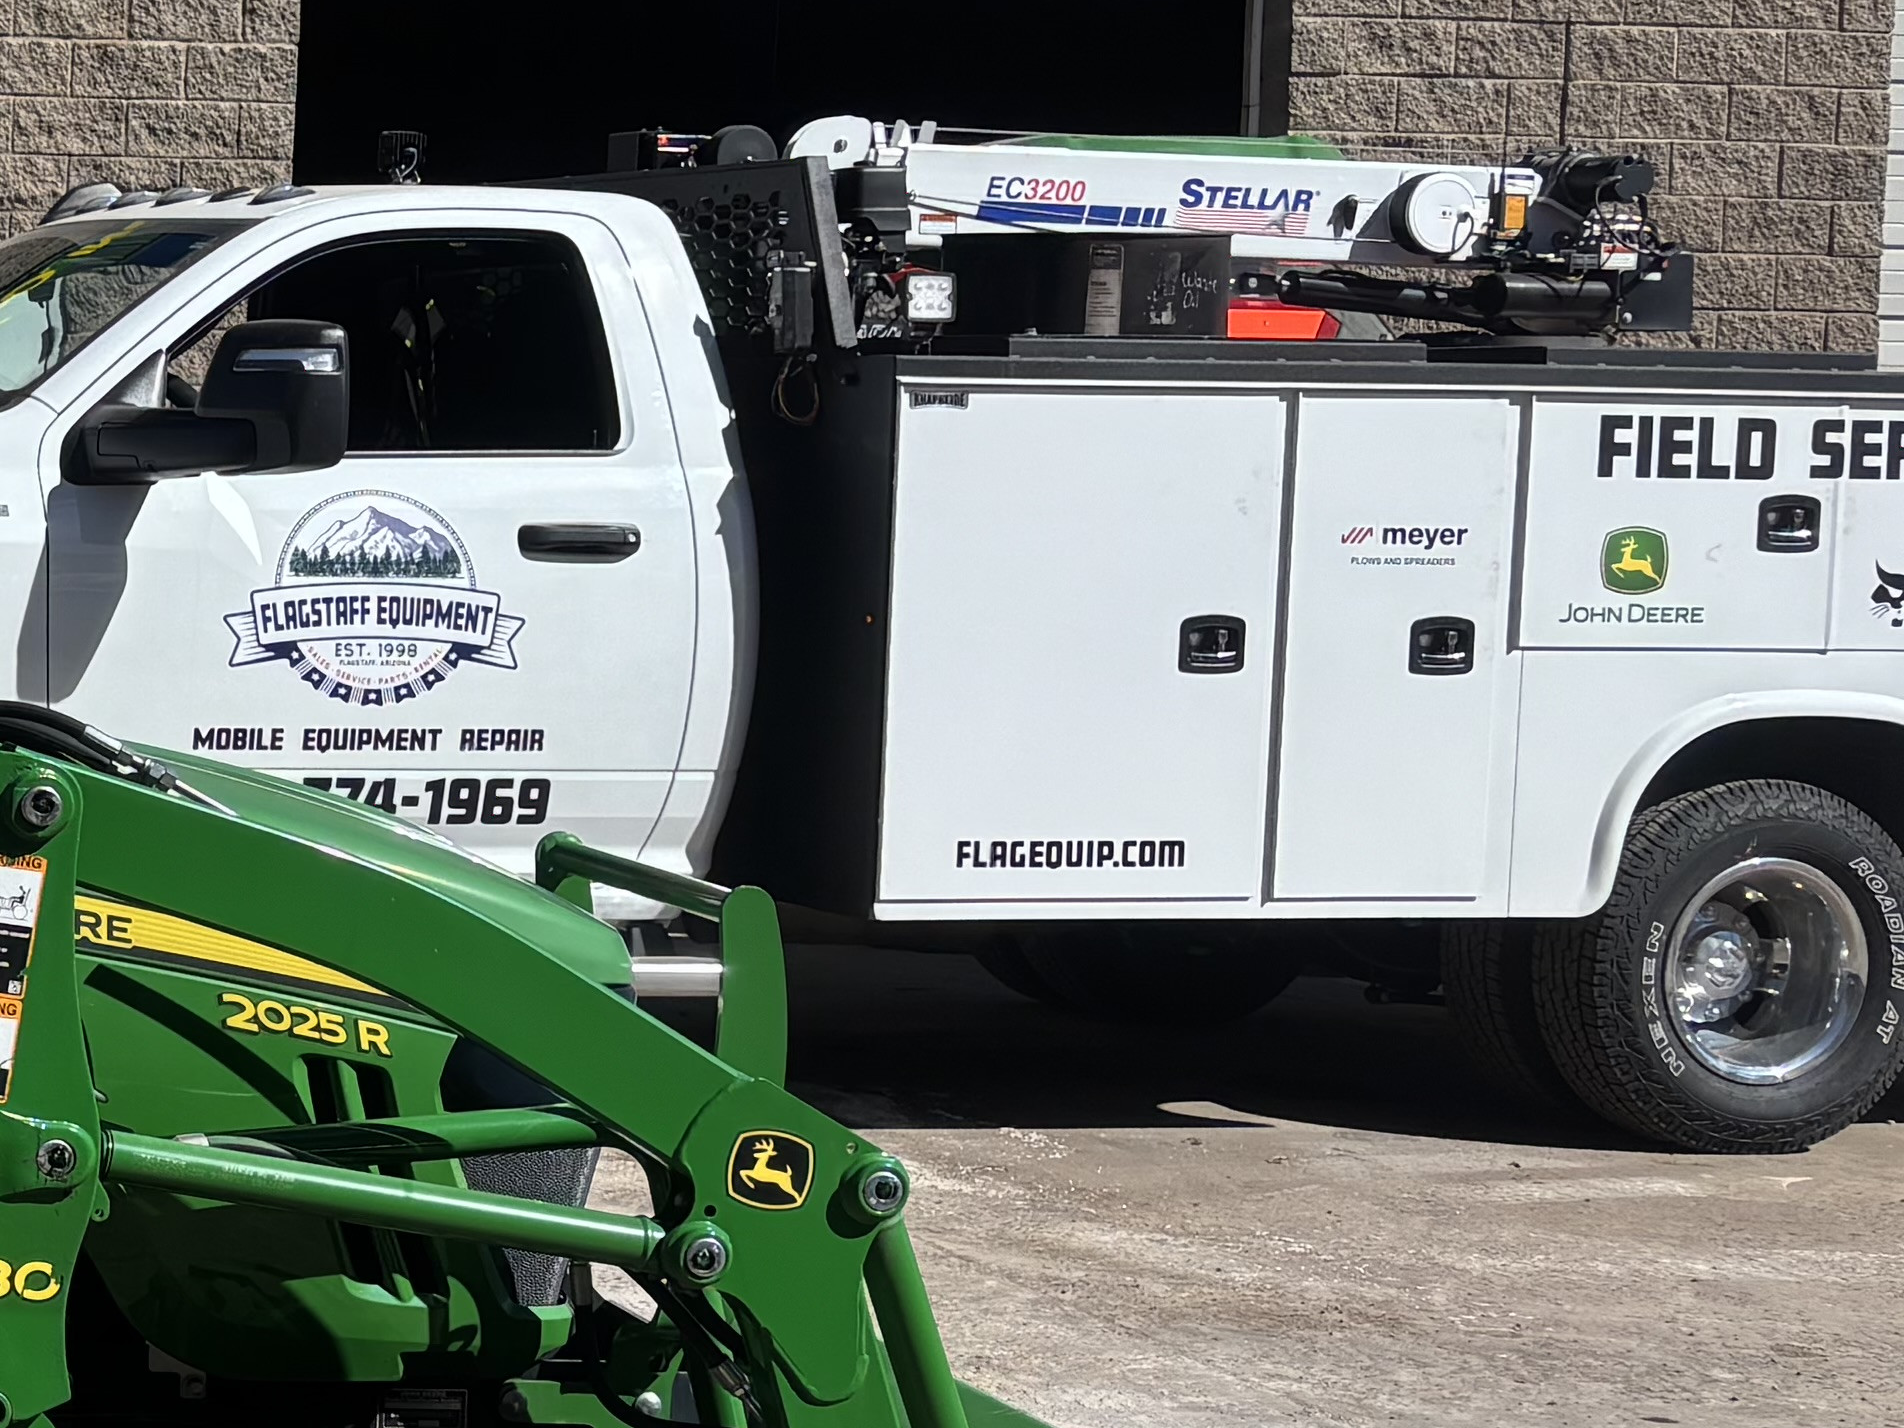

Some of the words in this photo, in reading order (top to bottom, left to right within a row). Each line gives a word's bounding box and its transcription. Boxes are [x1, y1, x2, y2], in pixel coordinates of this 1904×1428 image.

[986, 176, 1087, 202] EC3200
[1596, 415, 1777, 480] FIELD
[1382, 527, 1468, 550] meyer
[1350, 556, 1381, 566] PLOWS
[1383, 557, 1402, 566] AND
[1403, 557, 1456, 566] SPREADERS
[260, 595, 371, 634] FLAGSTAFF
[376, 595, 494, 636] EQUIPMENT
[1558, 603, 1622, 623] JOHN
[1628, 603, 1705, 623] DEERE
[334, 642, 371, 658] EST.
[378, 642, 418, 658] 1998
[307, 645, 331, 671] SALES
[335, 668, 371, 686] SERVICE
[378, 672, 409, 686] PARTS
[413, 647, 443, 675] RENTAL
[192, 728, 285, 751] MOBILE
[302, 728, 443, 754] EQUIPMENT
[459, 728, 545, 752] REPAIR
[956, 840, 1186, 869] FLAGEQUIP.COM
[1642, 921, 1685, 1077] NEXEN
[218, 992, 348, 1044] 2025
[1876, 999, 1900, 1045] AT
